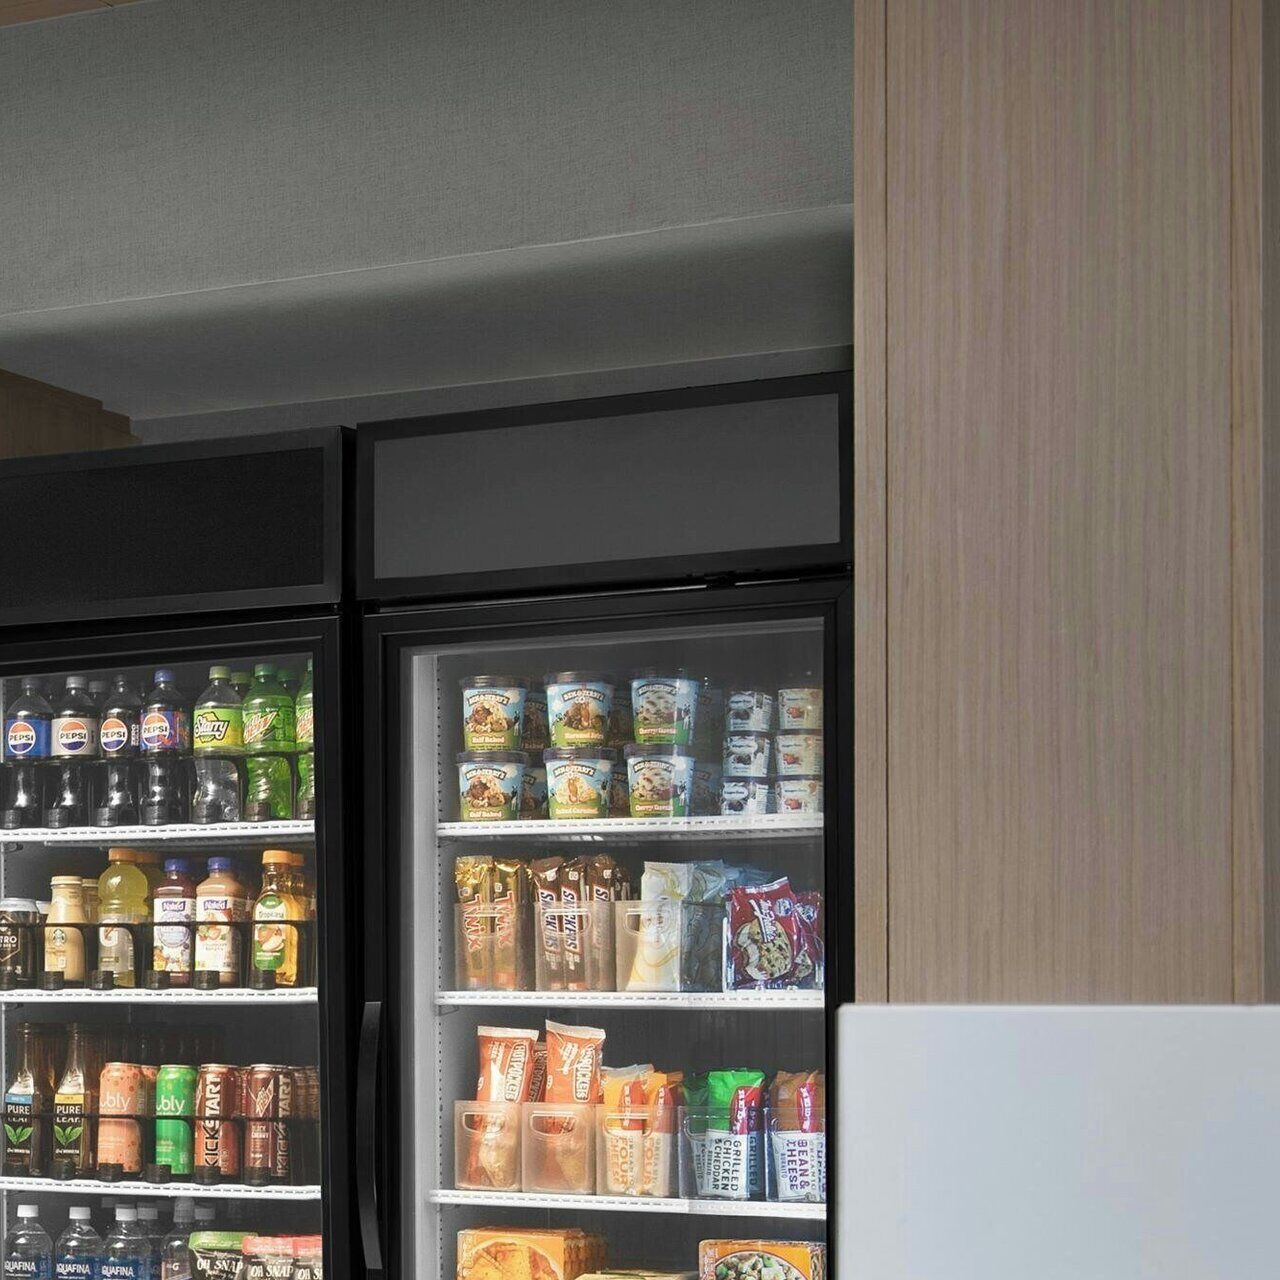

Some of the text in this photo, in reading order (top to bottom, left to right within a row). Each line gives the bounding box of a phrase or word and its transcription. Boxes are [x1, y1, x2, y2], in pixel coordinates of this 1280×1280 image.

[142, 724, 168, 734] PEPSI
[194, 713, 230, 741] Starry
[639, 727, 658, 736] Cherry
[9, 734, 34, 742] PEPSI
[59, 731, 87, 741] PEPSI
[101, 730, 127, 739] PEPSI
[635, 804, 653, 812] Cherry
[258, 910, 284, 919] Tropicana
[505, 1060, 524, 1100] POCKETS
[6, 1104, 31, 1115] PURE
[56, 1104, 81, 1115] PURE
[721, 1139, 732, 1191] CHICKEN
[749, 1136, 758, 1187] GRILLED
[797, 1140, 809, 1179] BEAN
[711, 1146, 723, 1190] CHEDDAR
[730, 1140, 742, 1192] GRILLED
[101, 1264, 135, 1278] QUAFINA
[196, 1259, 211, 1271] OH
[251, 1265, 294, 1278] OH SNAP
